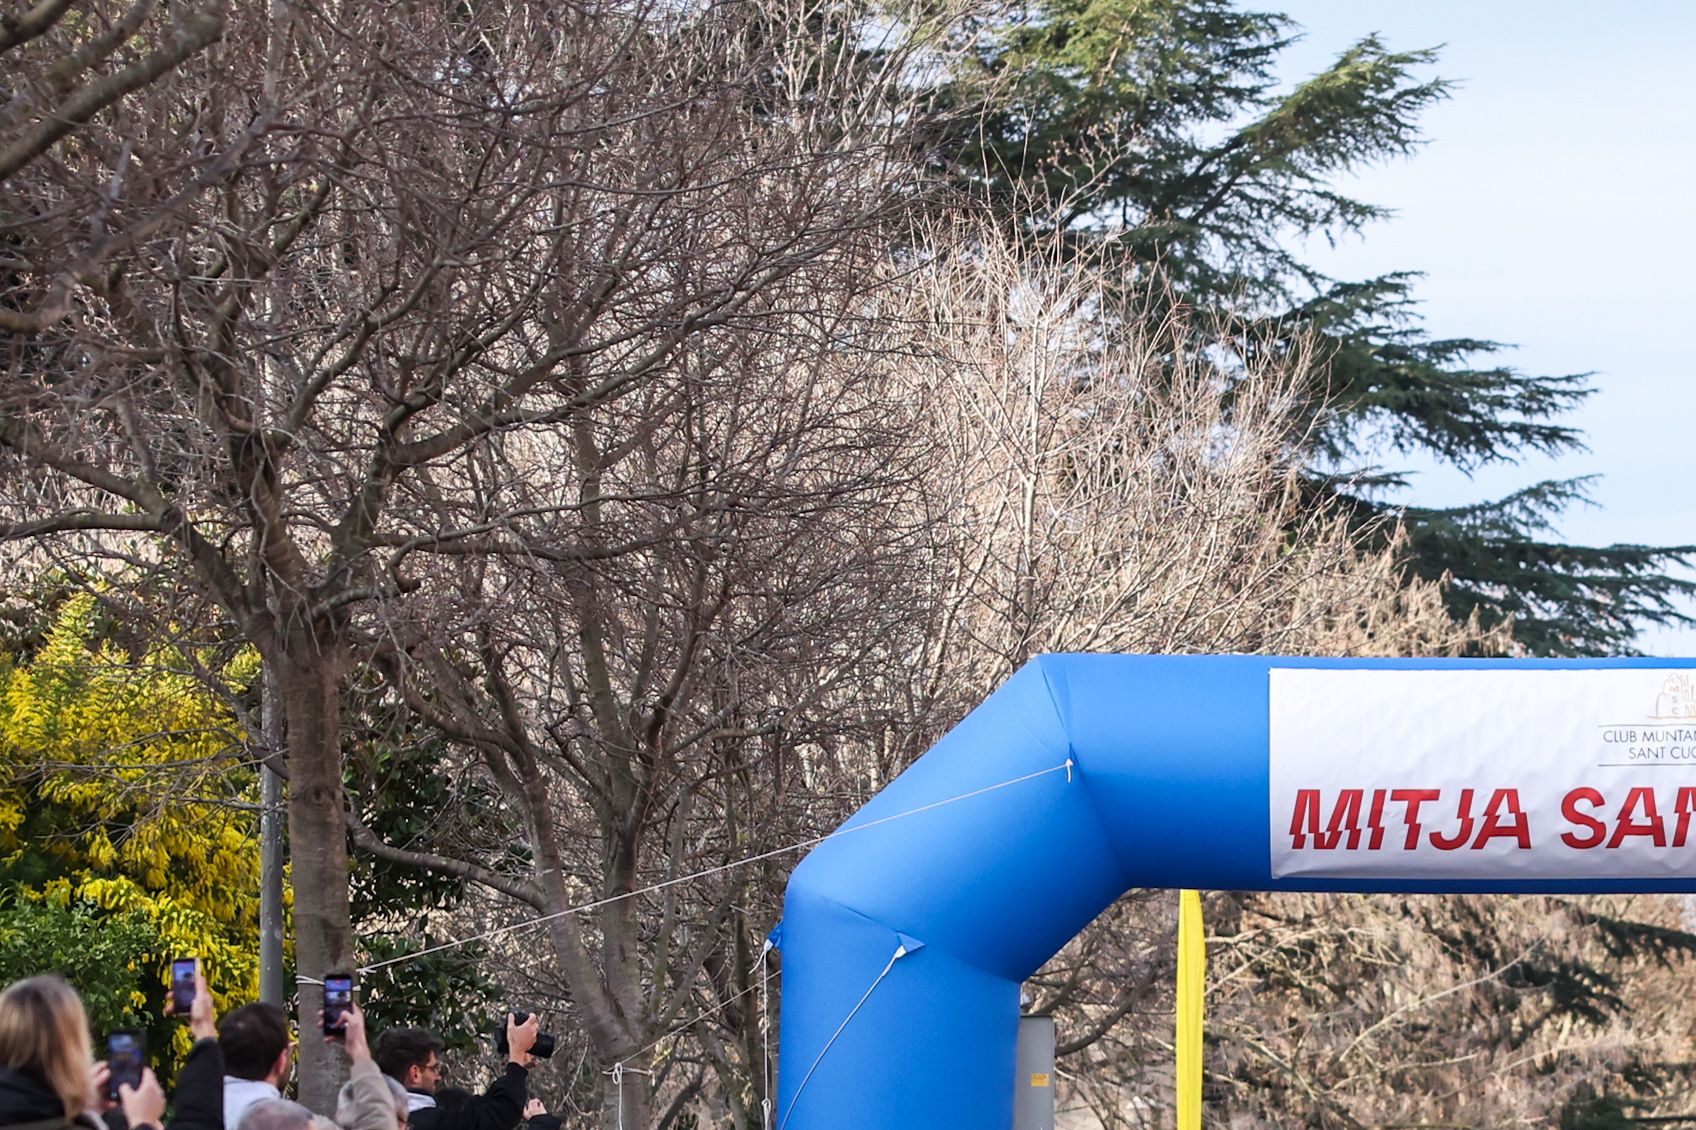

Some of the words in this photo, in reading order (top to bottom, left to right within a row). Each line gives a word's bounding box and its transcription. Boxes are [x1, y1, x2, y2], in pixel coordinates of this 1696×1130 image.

[1602, 730, 1637, 743] CLUB
[1628, 746, 1666, 760] SANT
[1289, 789, 1530, 850] MITJA
